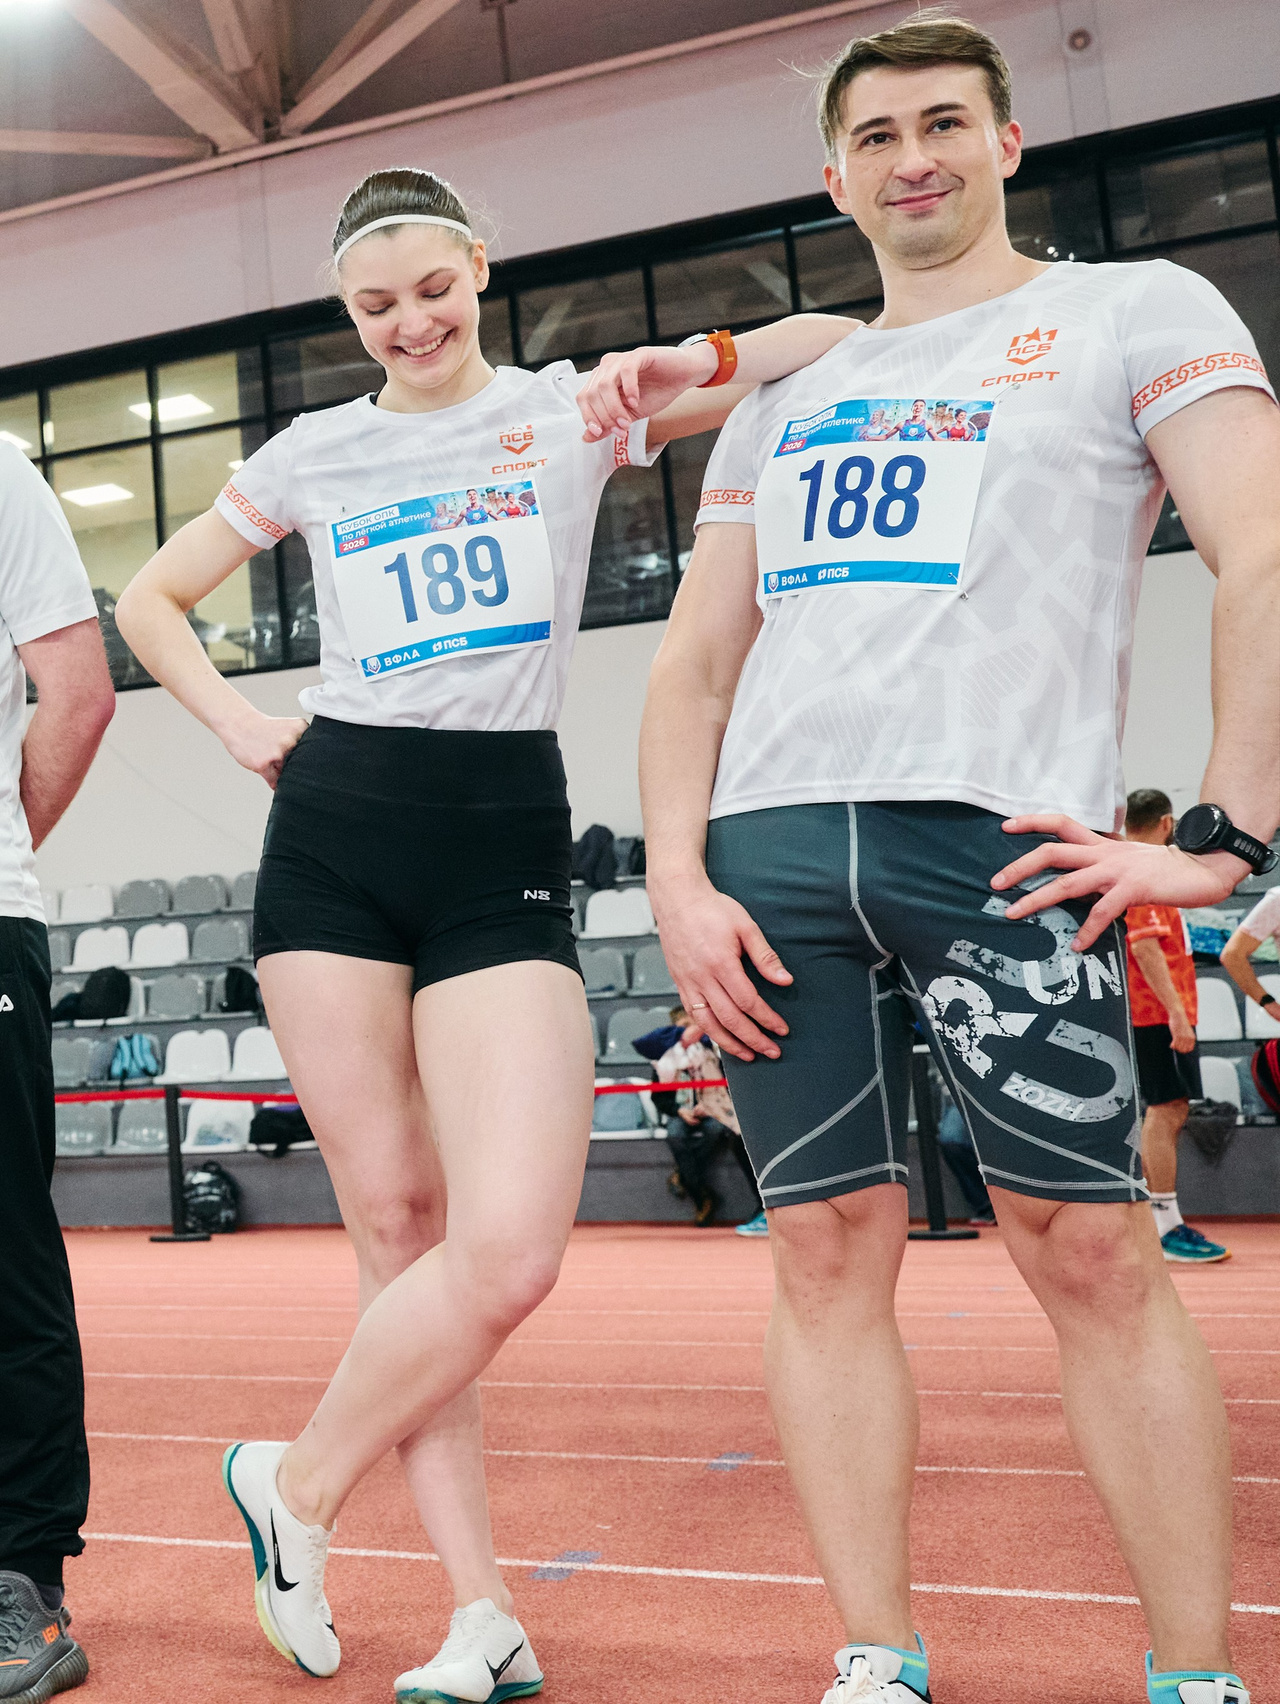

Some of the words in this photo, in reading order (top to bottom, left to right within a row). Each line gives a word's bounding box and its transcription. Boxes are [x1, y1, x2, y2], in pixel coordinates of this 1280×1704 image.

[1006, 342, 1052, 358] ПСБ
[981, 371, 1061, 387] СПОРТ
[822, 417, 864, 429] атлетике
[499, 431, 534, 444] ПСБ
[782, 441, 803, 452] 2026
[798, 454, 927, 543] 188
[341, 516, 373, 532] КУБОК
[374, 508, 396, 521] ОПК
[342, 533, 354, 542] по
[388, 511, 432, 527] атлетике
[342, 538, 366, 551] 2026
[383, 535, 510, 624] 189
[781, 572, 808, 587] ВФЛА
[827, 567, 850, 579] ПСБ
[383, 649, 421, 667] ВФЛА
[443, 636, 468, 650] ПСБ
[1004, 1073, 1087, 1122] ZOZH
